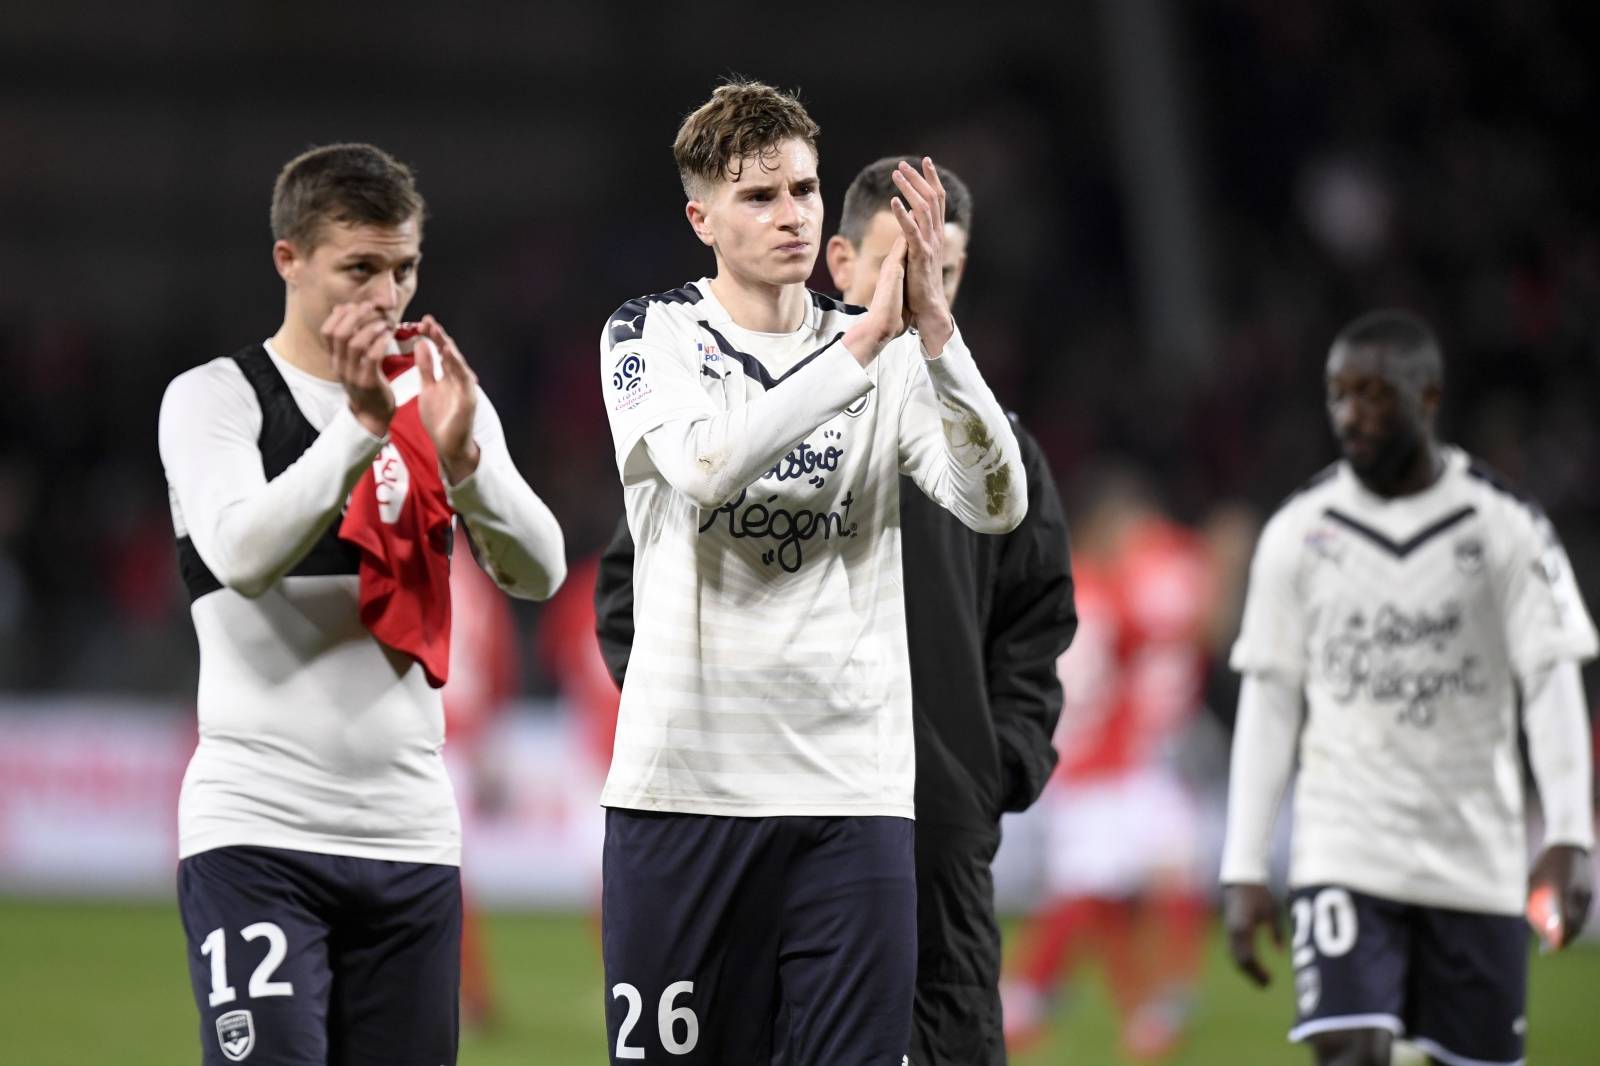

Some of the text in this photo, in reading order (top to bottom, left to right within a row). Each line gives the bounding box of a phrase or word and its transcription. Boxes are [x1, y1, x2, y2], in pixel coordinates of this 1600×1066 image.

[761, 442, 844, 481] istro
[200, 921, 295, 1008] 12
[1290, 887, 1359, 969] 20
[611, 980, 700, 1060] 26
